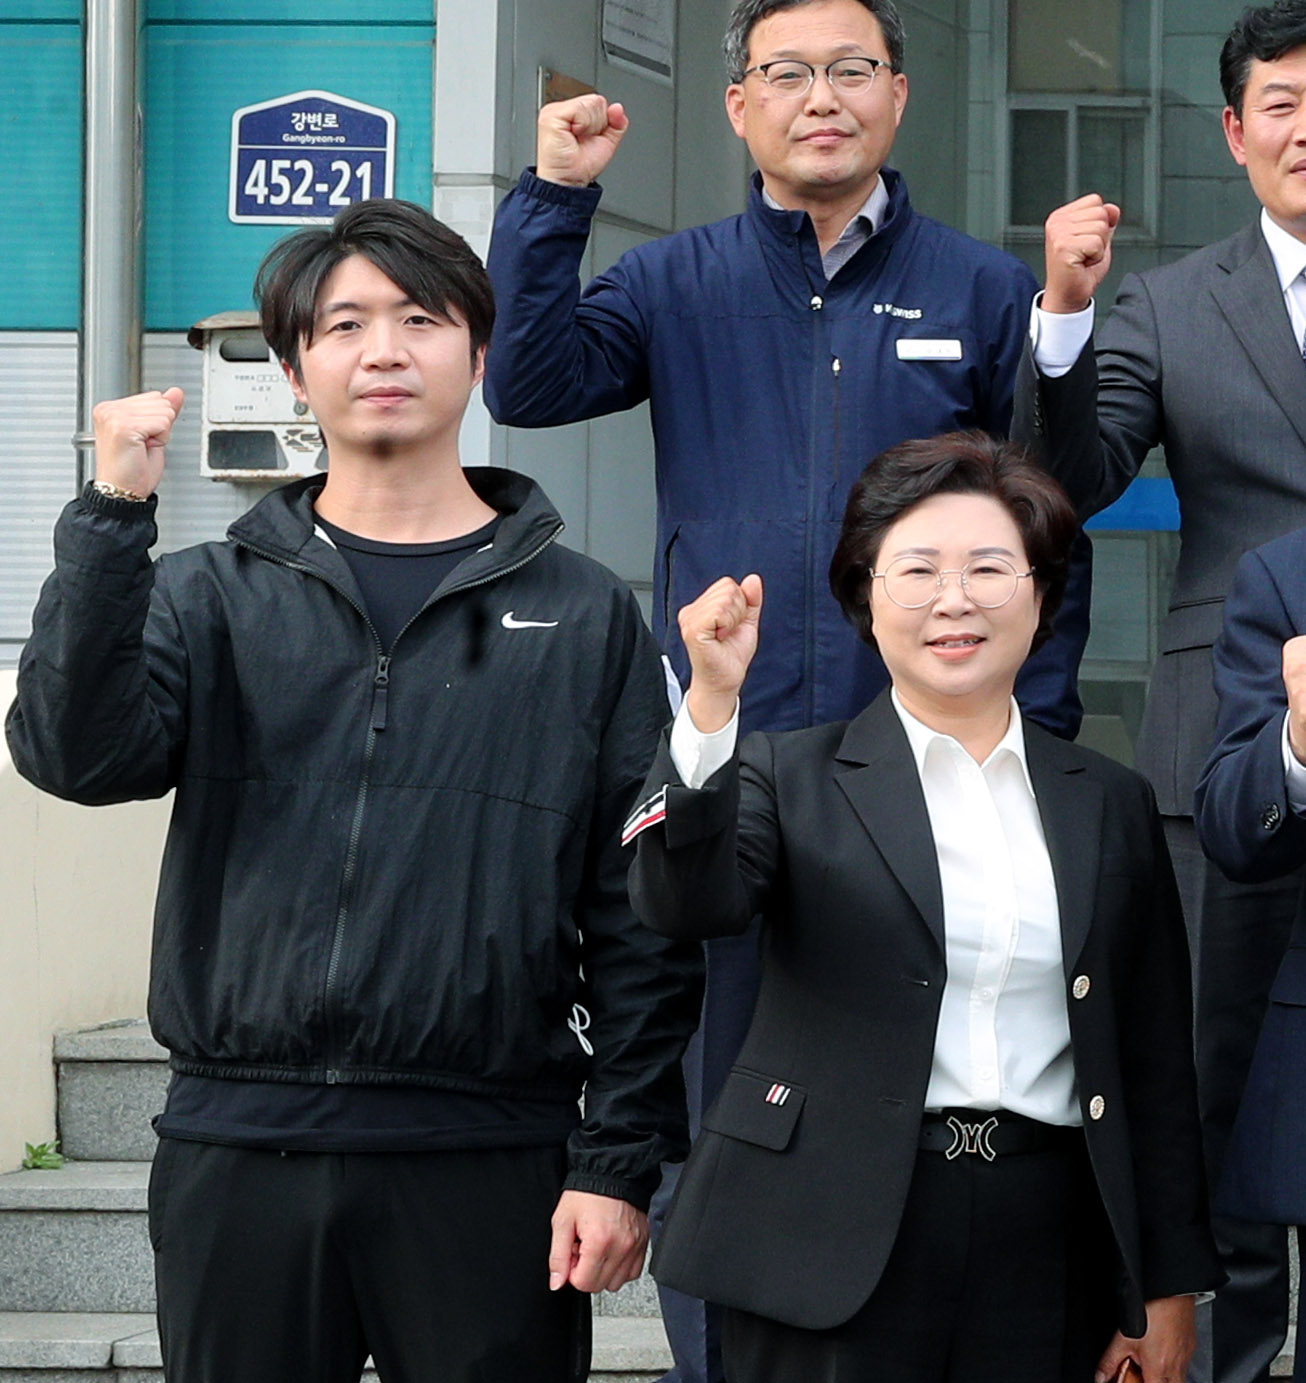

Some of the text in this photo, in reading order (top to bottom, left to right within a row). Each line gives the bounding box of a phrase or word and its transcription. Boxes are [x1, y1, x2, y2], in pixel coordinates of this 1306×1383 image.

[291, 112, 339, 132] 강변로
[282, 133, 346, 145] Gangbyeon-ro
[244, 159, 372, 205] 452-21
